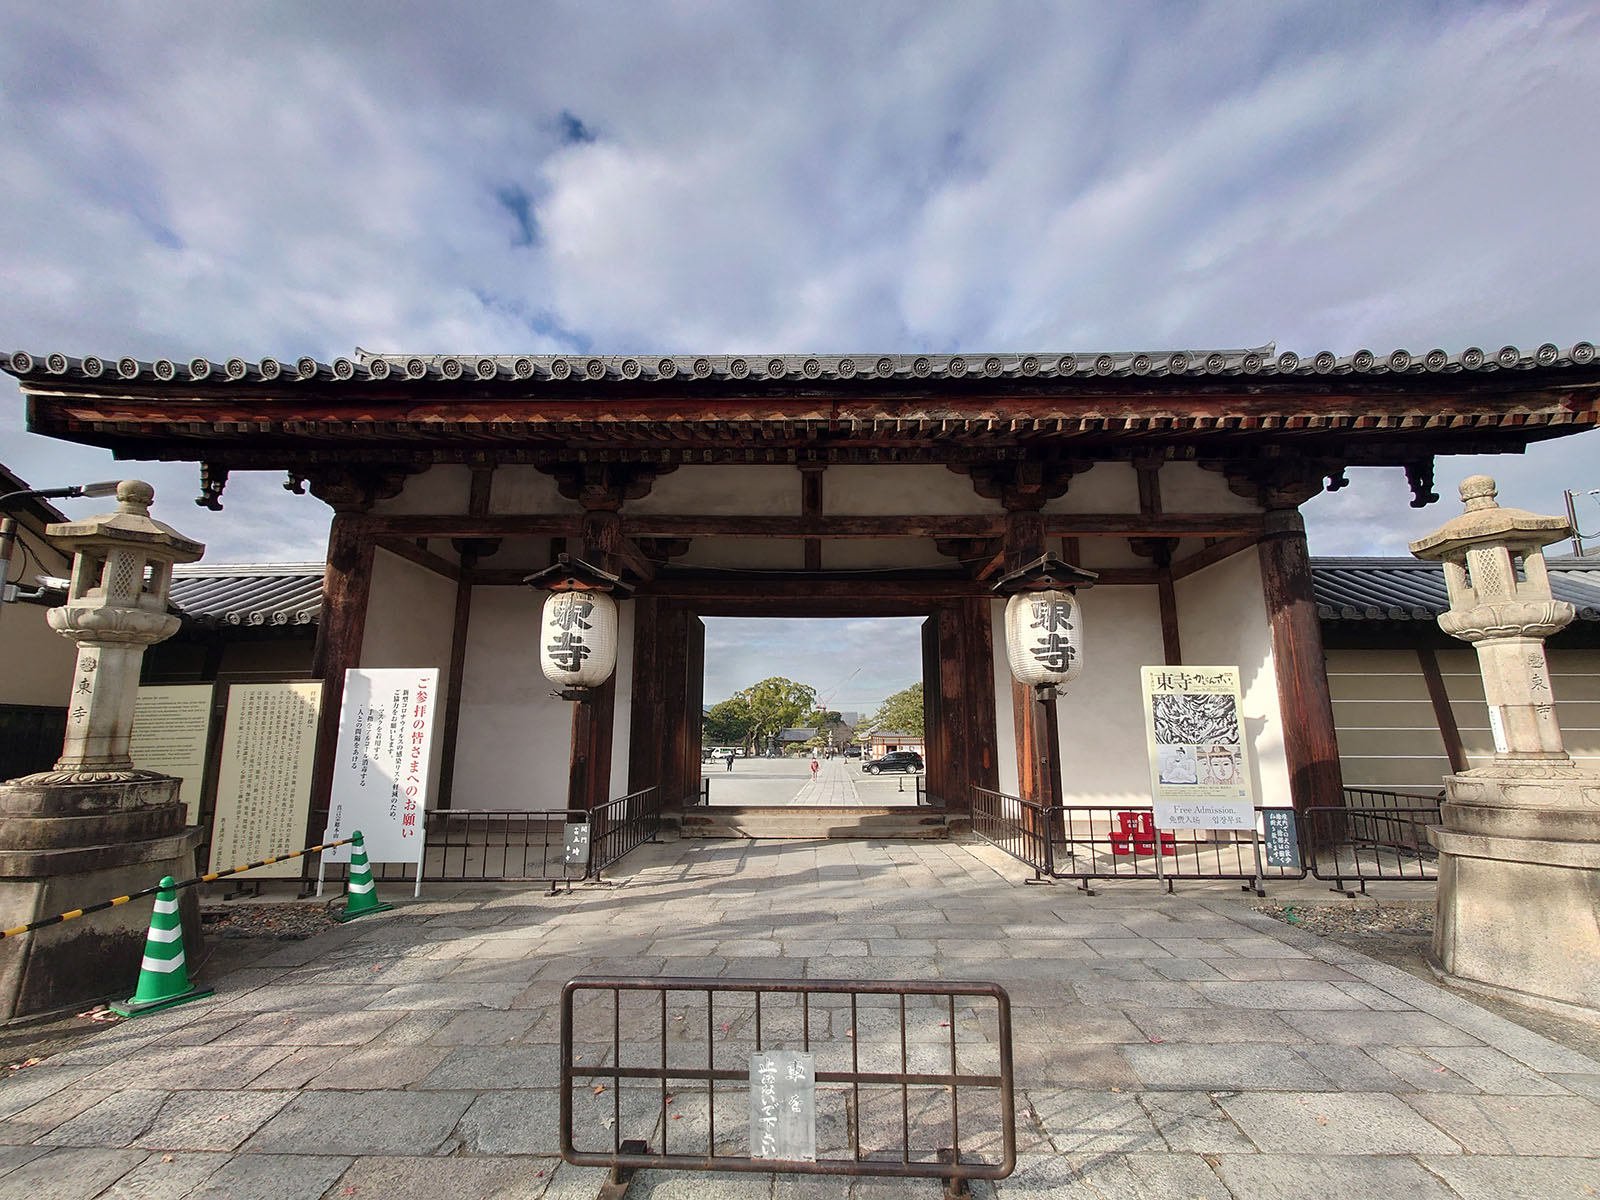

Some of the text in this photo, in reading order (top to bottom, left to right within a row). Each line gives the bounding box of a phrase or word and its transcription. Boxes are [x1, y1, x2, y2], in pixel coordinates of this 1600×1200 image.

[547, 593, 594, 672] 東寺
[1029, 591, 1076, 673] 東寺
[72, 678, 92, 724] 東寺
[1531, 673, 1551, 720] 東寺
[402, 677, 430, 838] ご参拝の皆さまへのお願い
[1173, 805, 1236, 814] Free Admission.
[1212, 816, 1242, 824] 입장무료
[758, 1057, 779, 1155] 止めないで下さい
